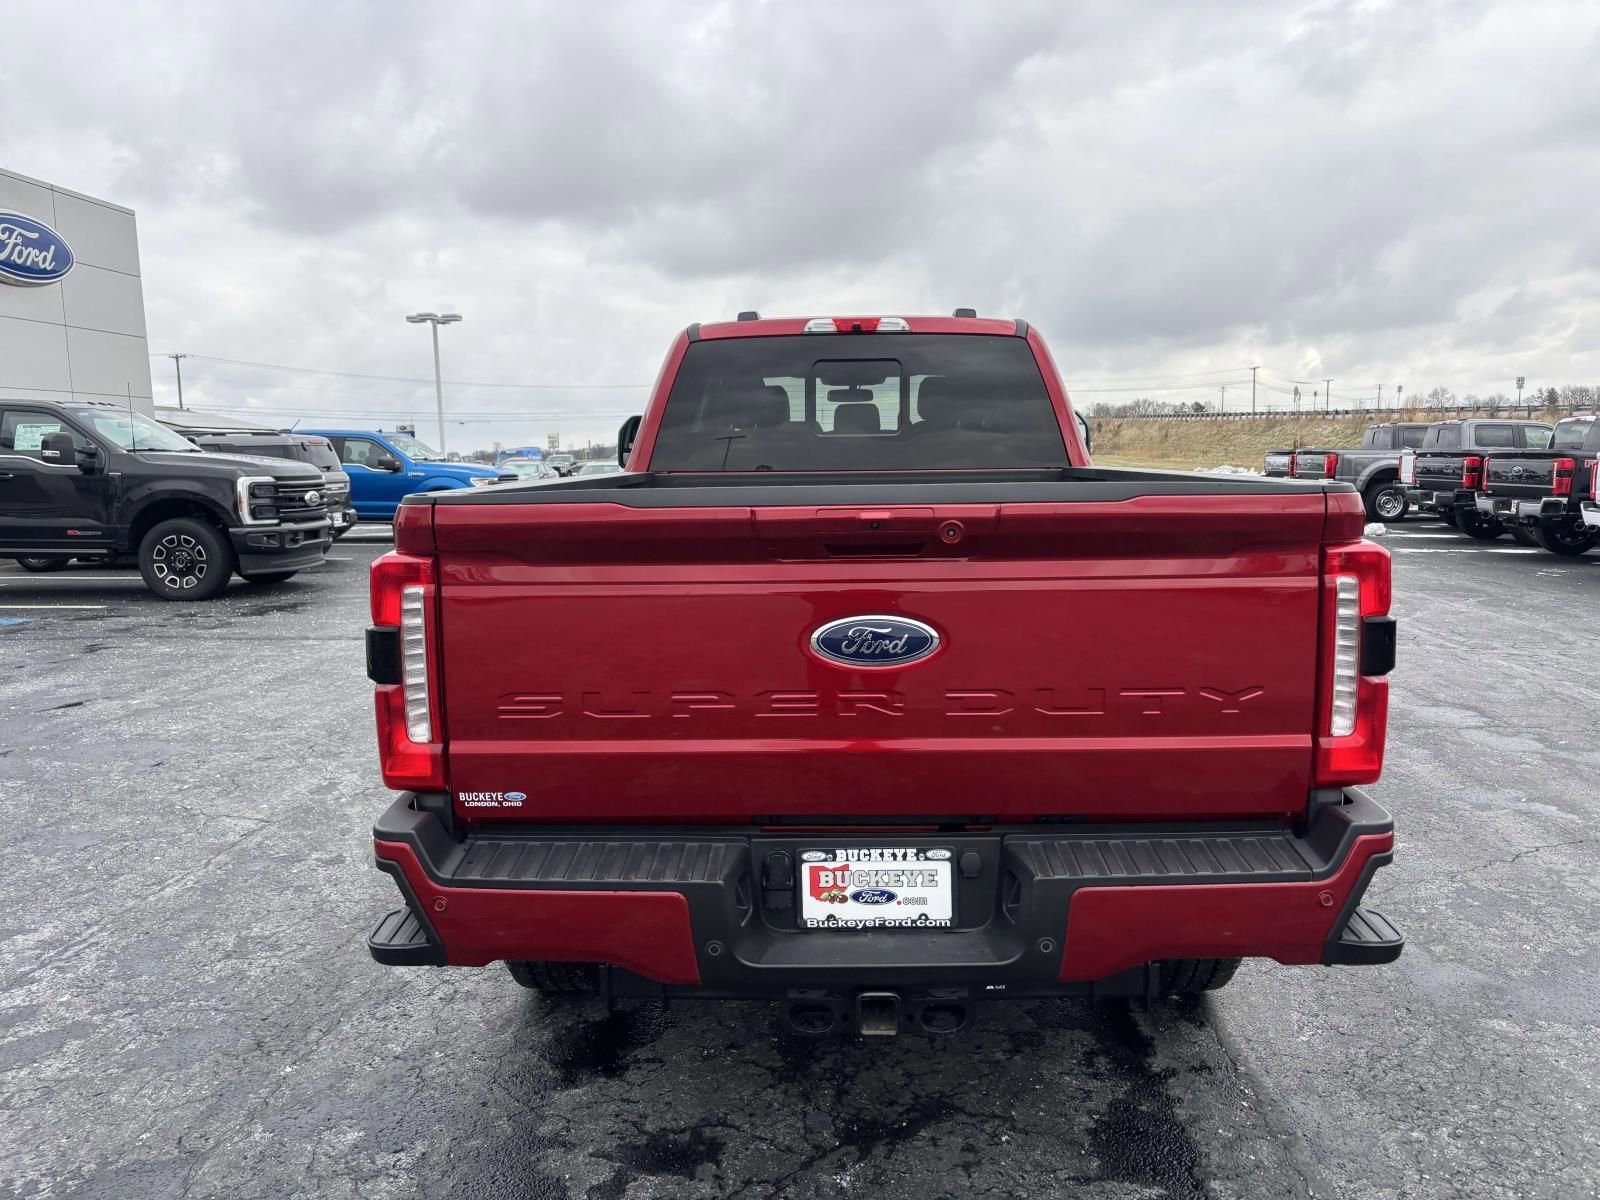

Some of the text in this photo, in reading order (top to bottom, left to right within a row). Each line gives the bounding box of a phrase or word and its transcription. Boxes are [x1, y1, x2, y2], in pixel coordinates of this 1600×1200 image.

[0, 223, 56, 271] Ford
[841, 626, 908, 655] Ford
[496, 686, 1265, 718] SUPER DUTY
[459, 792, 504, 801] BUCKEYE
[835, 849, 918, 862] BUCKEYE
[818, 869, 939, 887] BUCKEYE
[859, 890, 928, 905] Ford .com
[806, 917, 951, 930] BuckeyeFord.com
